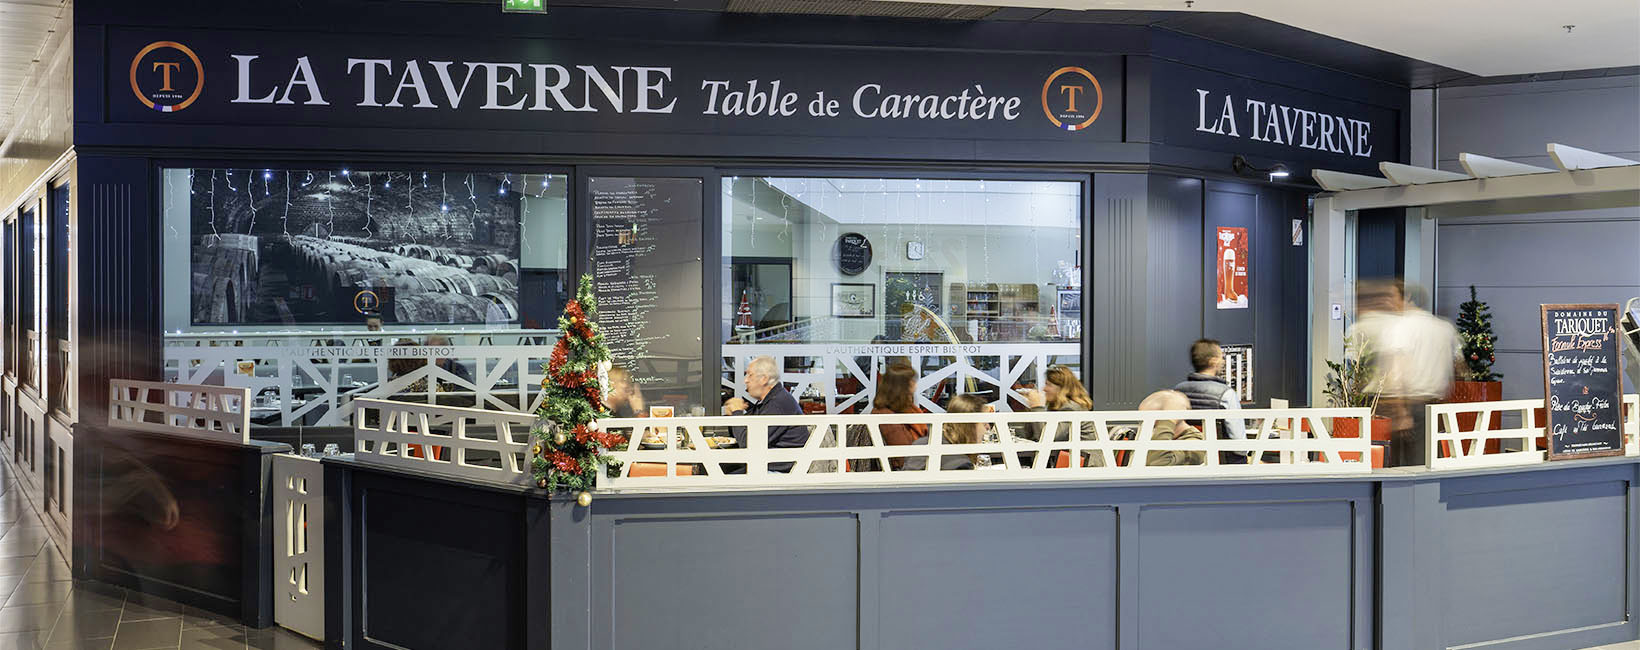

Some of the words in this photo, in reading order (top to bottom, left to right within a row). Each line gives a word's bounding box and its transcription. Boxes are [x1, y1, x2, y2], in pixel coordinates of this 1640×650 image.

[153, 62, 181, 91] T
[230, 54, 330, 105] LA
[347, 57, 678, 114] TAVERNE
[701, 79, 798, 117] Table
[808, 92, 840, 117] de
[852, 84, 1021, 121] Caractère
[1061, 85, 1083, 112] T
[1196, 88, 1240, 137] LA
[1246, 99, 1373, 158] TAVERNE
[1554, 318, 1608, 337] TARIQUET
[281, 347, 369, 357] 'AUTHENTIQUE
[373, 347, 408, 357] ESPRIT
[412, 347, 455, 357] BISTROT
[827, 346, 905, 354] L'AUTHENTIQUE
[908, 346, 939, 354] ESPRIT
[1576, 336, 1602, 352] Express
[1553, 424, 1568, 441] Café
